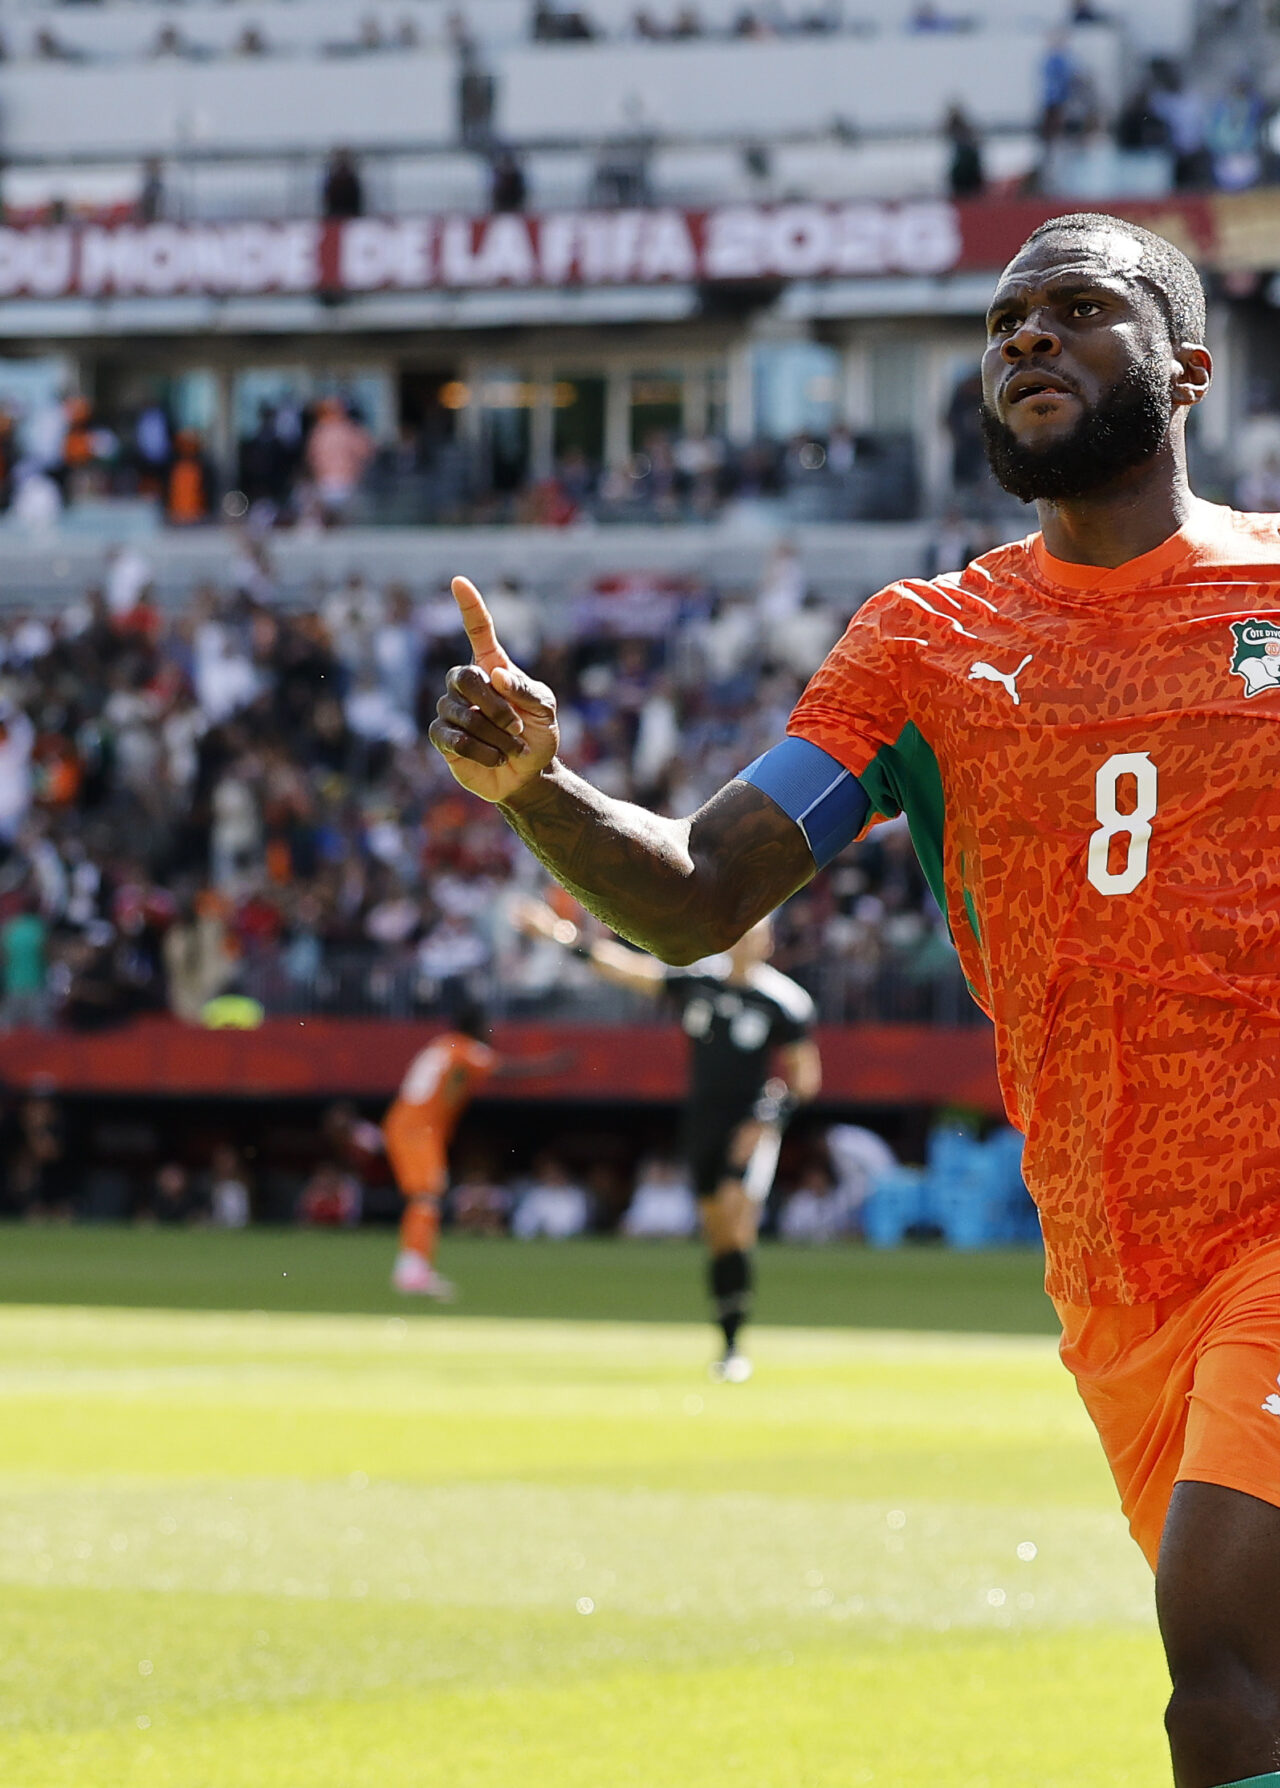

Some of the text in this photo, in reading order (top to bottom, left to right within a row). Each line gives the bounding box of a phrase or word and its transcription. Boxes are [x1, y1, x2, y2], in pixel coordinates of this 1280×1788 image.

[80, 222, 318, 295] MONDE
[340, 217, 437, 291] DE
[443, 214, 537, 286] LA
[539, 208, 697, 283] FIFA
[703, 204, 961, 277] 2026
[1087, 752, 1157, 895] 8
